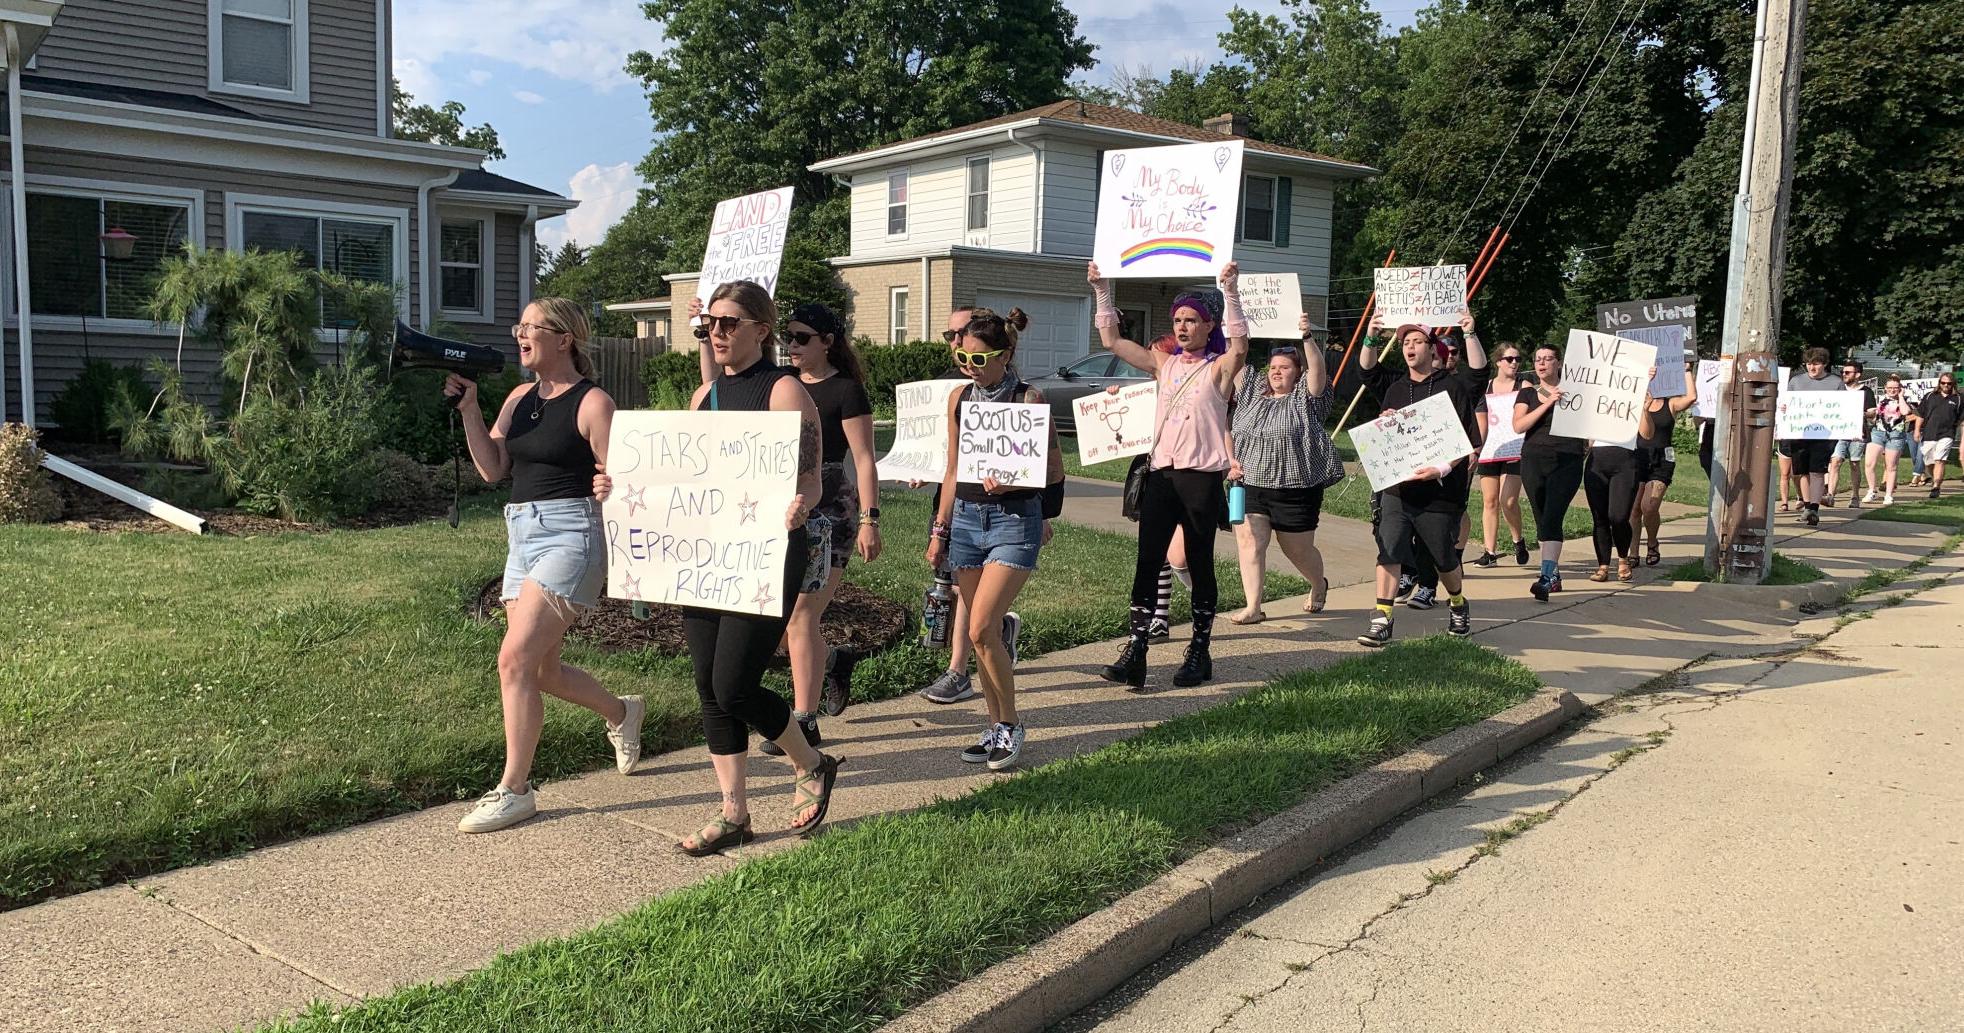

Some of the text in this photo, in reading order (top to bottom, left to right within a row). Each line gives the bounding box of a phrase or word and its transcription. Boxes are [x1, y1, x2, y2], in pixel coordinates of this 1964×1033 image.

[1134, 165, 1209, 207] My Body
[712, 191, 782, 236] LAND
[1122, 208, 1206, 238] My Choice
[1375, 282, 1387, 293] AN
[1418, 281, 1461, 292] CHICKEN
[1435, 289, 1464, 305] BABY
[1604, 307, 1632, 329] No
[444, 348, 467, 359] PYLE
[1587, 334, 1633, 370] WE
[1564, 363, 1602, 386] WILL
[1608, 370, 1645, 394] NOT
[897, 385, 932, 409] STAND
[1079, 401, 1098, 416] Keep
[1558, 391, 1638, 423] GO BACK
[618, 429, 798, 481] STARS AND STRIPES
[960, 431, 994, 455] Small
[1107, 440, 1119, 456] my
[1121, 436, 1152, 449] ovaries
[665, 486, 725, 528] AND
[607, 519, 777, 571] REPRODUCTIVE
[674, 568, 744, 606] RIGHTS
